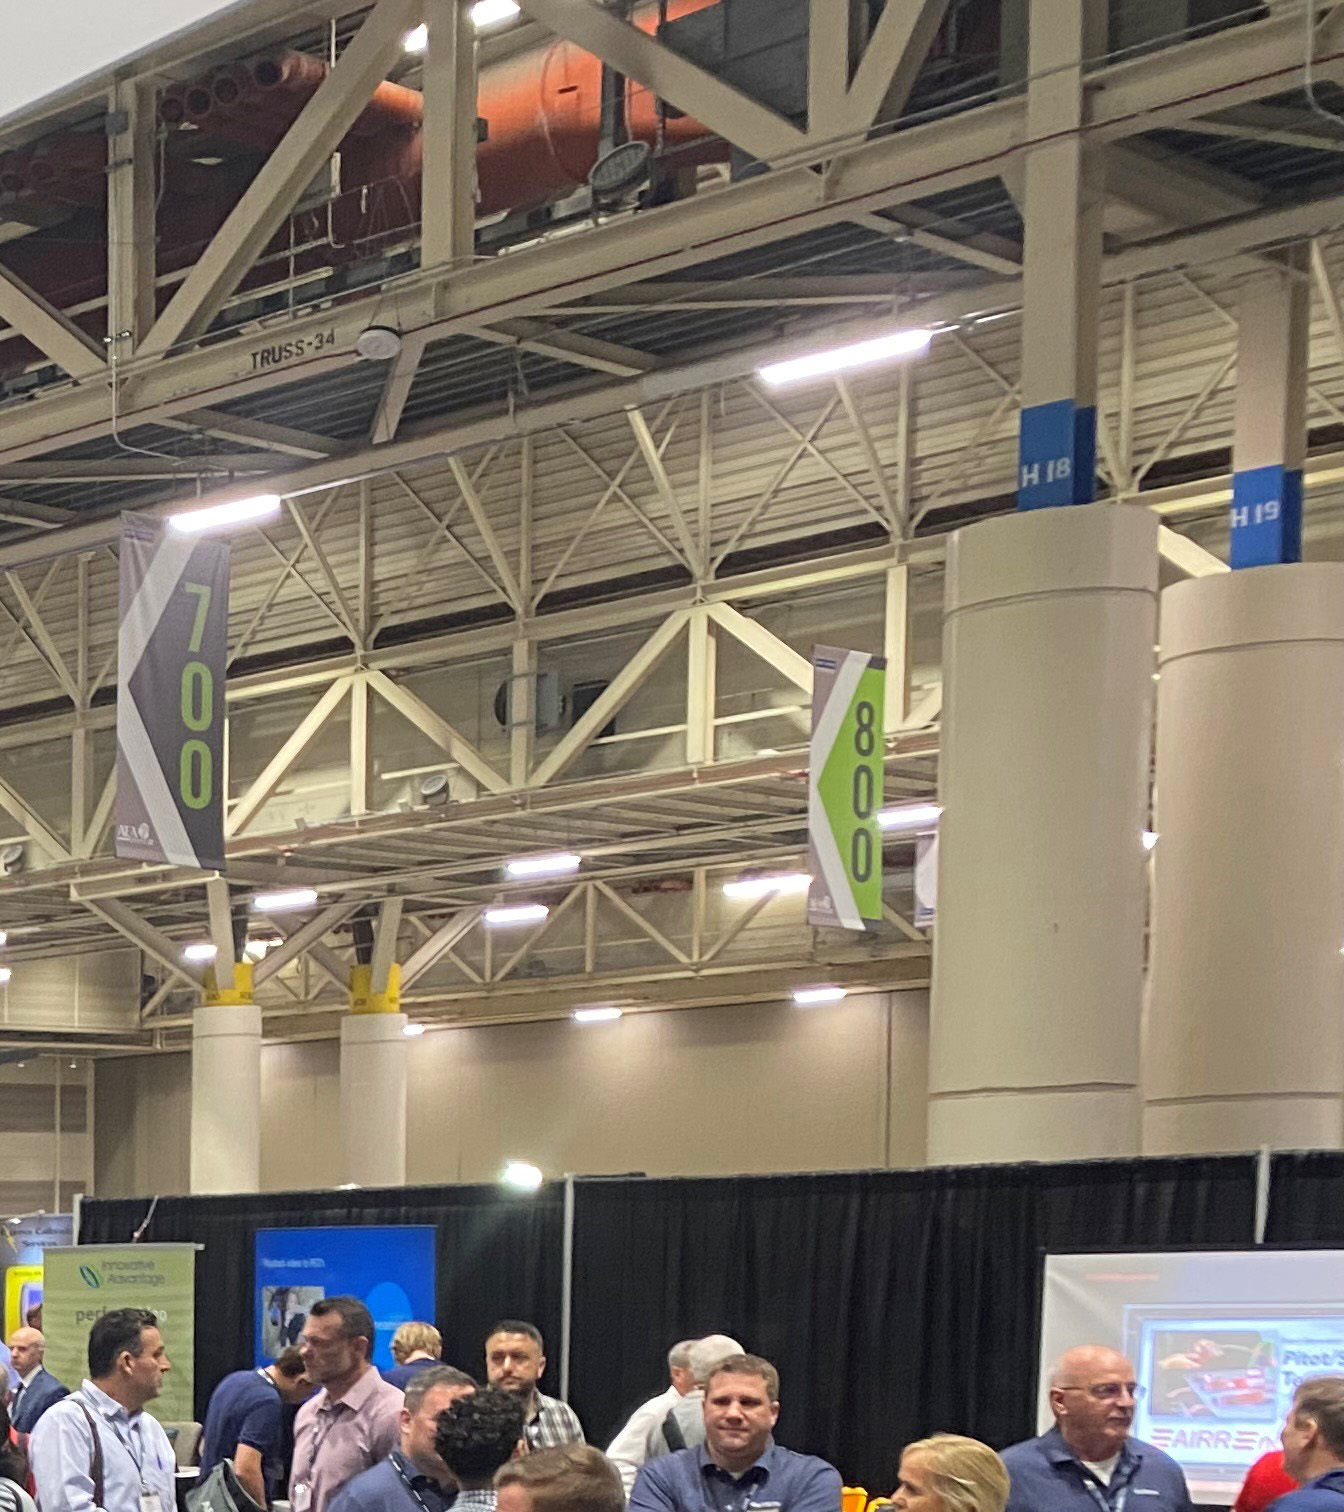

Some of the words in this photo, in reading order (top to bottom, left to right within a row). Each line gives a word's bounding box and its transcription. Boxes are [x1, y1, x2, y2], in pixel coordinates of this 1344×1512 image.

[250, 328, 336, 370] TRUSS-34
[1020, 463, 1039, 488] H
[1046, 457, 1072, 483] 18
[1230, 506, 1248, 528] H
[1254, 500, 1281, 524] 19
[180, 581, 214, 810] 700
[851, 701, 875, 883] 800
